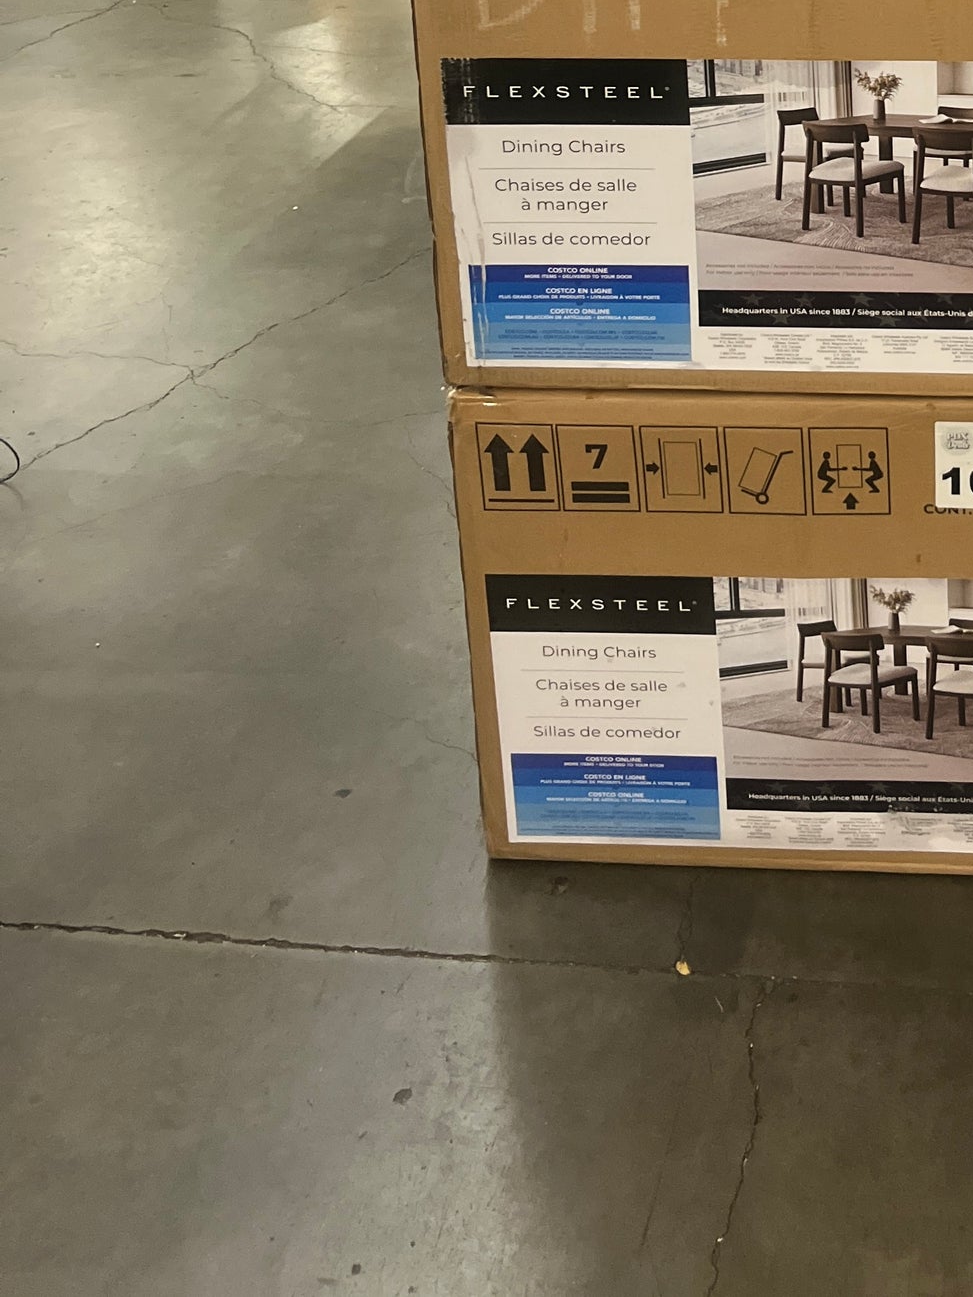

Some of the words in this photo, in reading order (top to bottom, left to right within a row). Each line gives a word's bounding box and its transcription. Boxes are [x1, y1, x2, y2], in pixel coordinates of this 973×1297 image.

[502, 140, 563, 156] Dining
[569, 140, 626, 153] Chairs
[495, 178, 564, 192] Chaises
[569, 178, 592, 192] de
[598, 178, 637, 192] salle
[521, 197, 531, 211] à
[537, 201, 608, 214] manger
[492, 232, 537, 246] Sillas
[542, 232, 565, 246] de
[570, 232, 651, 246] comedor
[723, 307, 778, 316] Headquarters
[858, 308, 880, 317] Siège
[882, 308, 905, 316] social
[924, 308, 966, 317] États-Unis
[585, 443, 607, 469] 7
[506, 598, 691, 612] FLEXSTEEL
[542, 645, 598, 660] Dining
[604, 646, 657, 659] Chairs
[536, 679, 600, 691] Chaises
[605, 679, 626, 692] de
[631, 680, 668, 692] salle
[560, 696, 569, 708] à
[575, 698, 641, 711] manger
[533, 725, 575, 738] Sillas
[580, 725, 601, 738] de
[606, 726, 681, 739] comedor
